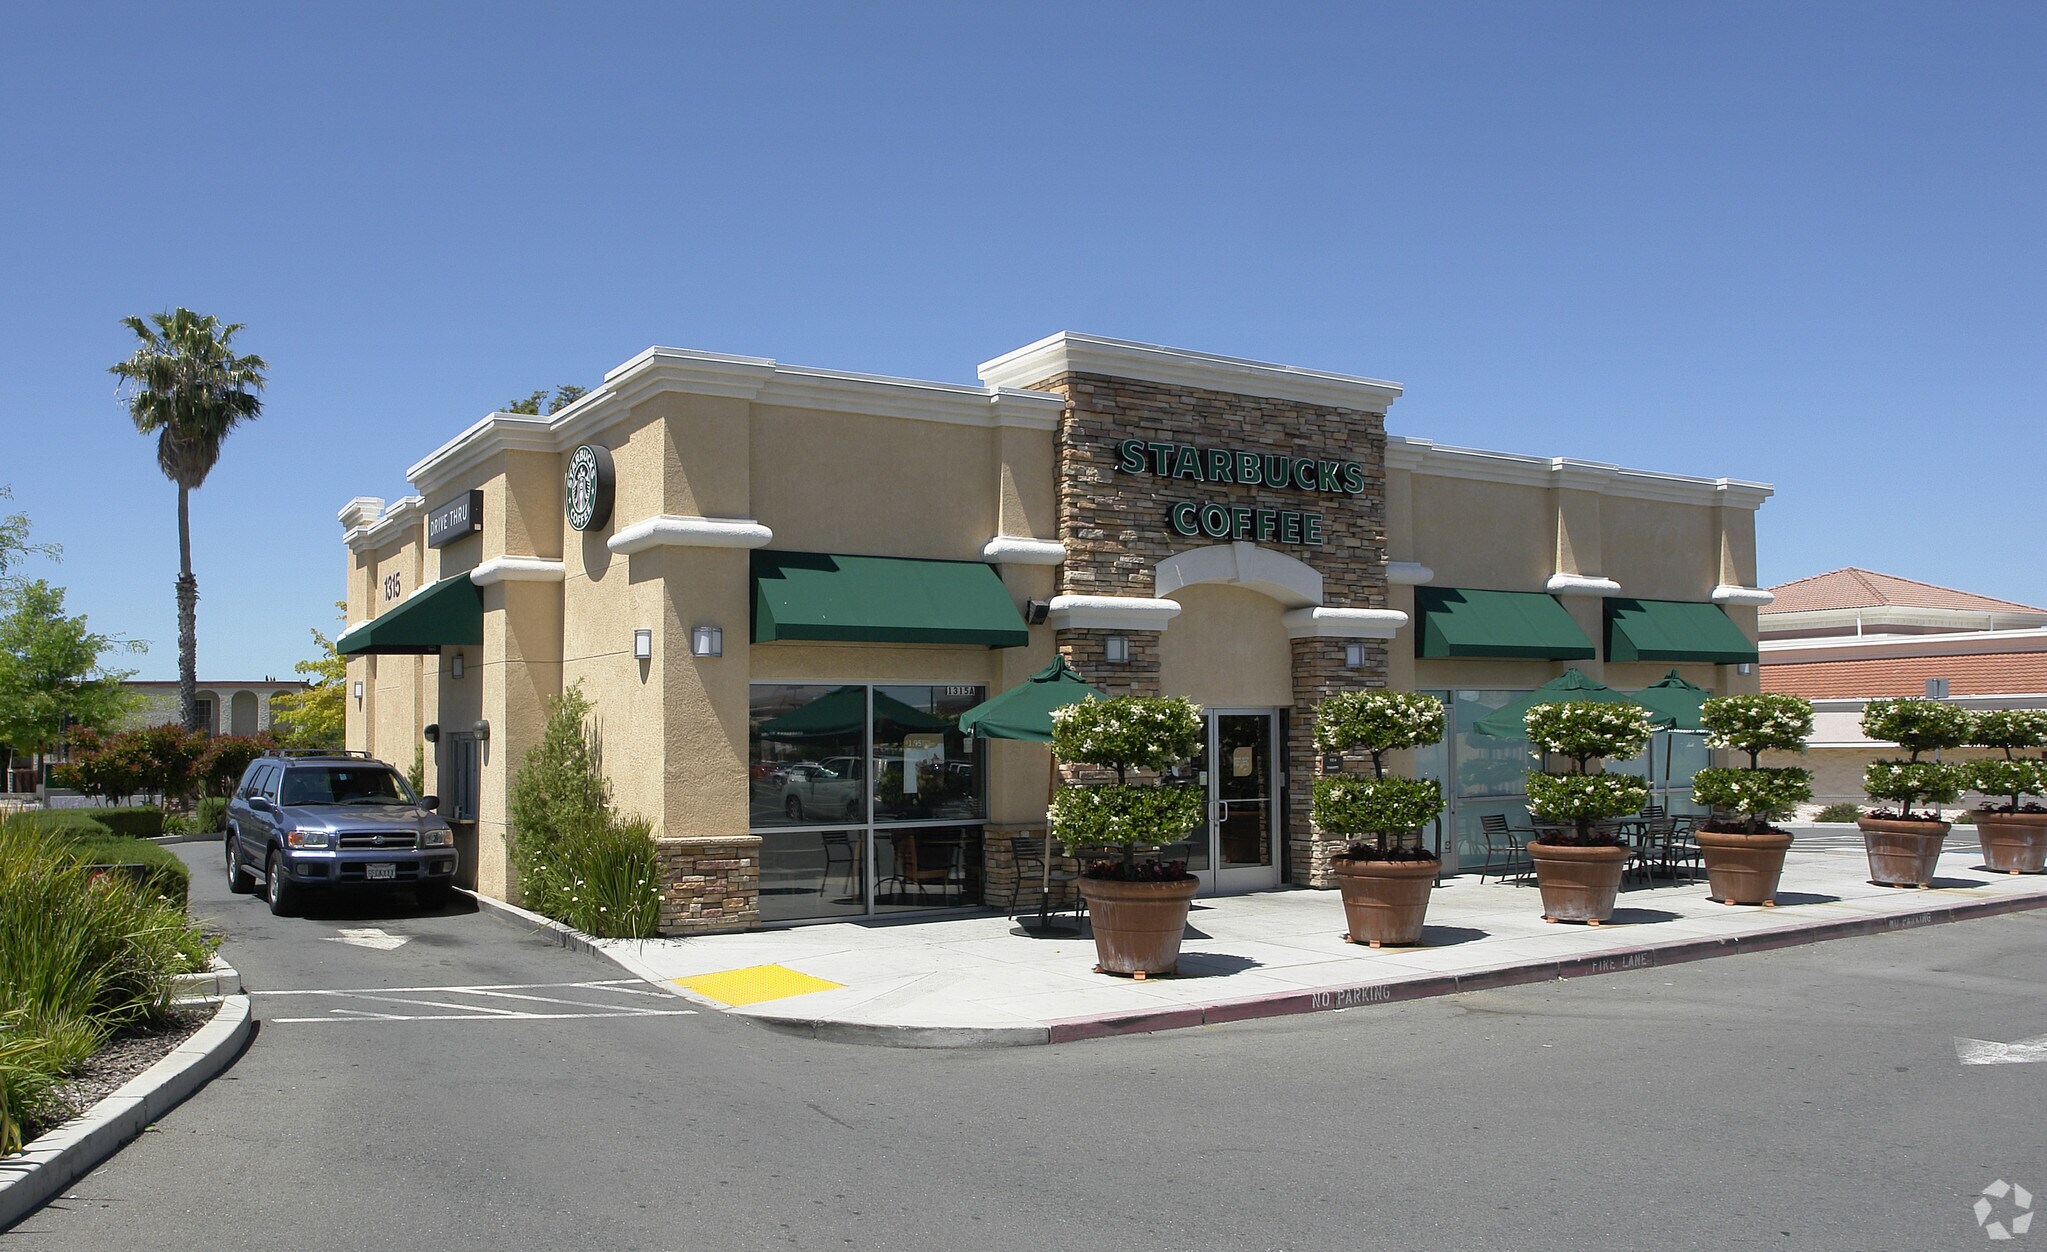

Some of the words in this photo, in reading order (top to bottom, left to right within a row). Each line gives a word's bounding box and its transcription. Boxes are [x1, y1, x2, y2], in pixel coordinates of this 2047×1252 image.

[567, 449, 596, 489] STARBUCKS
[1121, 439, 1365, 494] STARBUCKS
[430, 513, 448, 537] DRIVE
[450, 503, 468, 527] THRU
[570, 503, 592, 526] COFFEE
[1172, 501, 1324, 545] COFFEE
[384, 571, 401, 601] 1315
[947, 686, 976, 696] 1315A
[1592, 959, 1616, 973] FIRE
[1622, 952, 1648, 968] LANE
[1312, 991, 1330, 1008] NO
[1337, 985, 1390, 1005] PARKING
